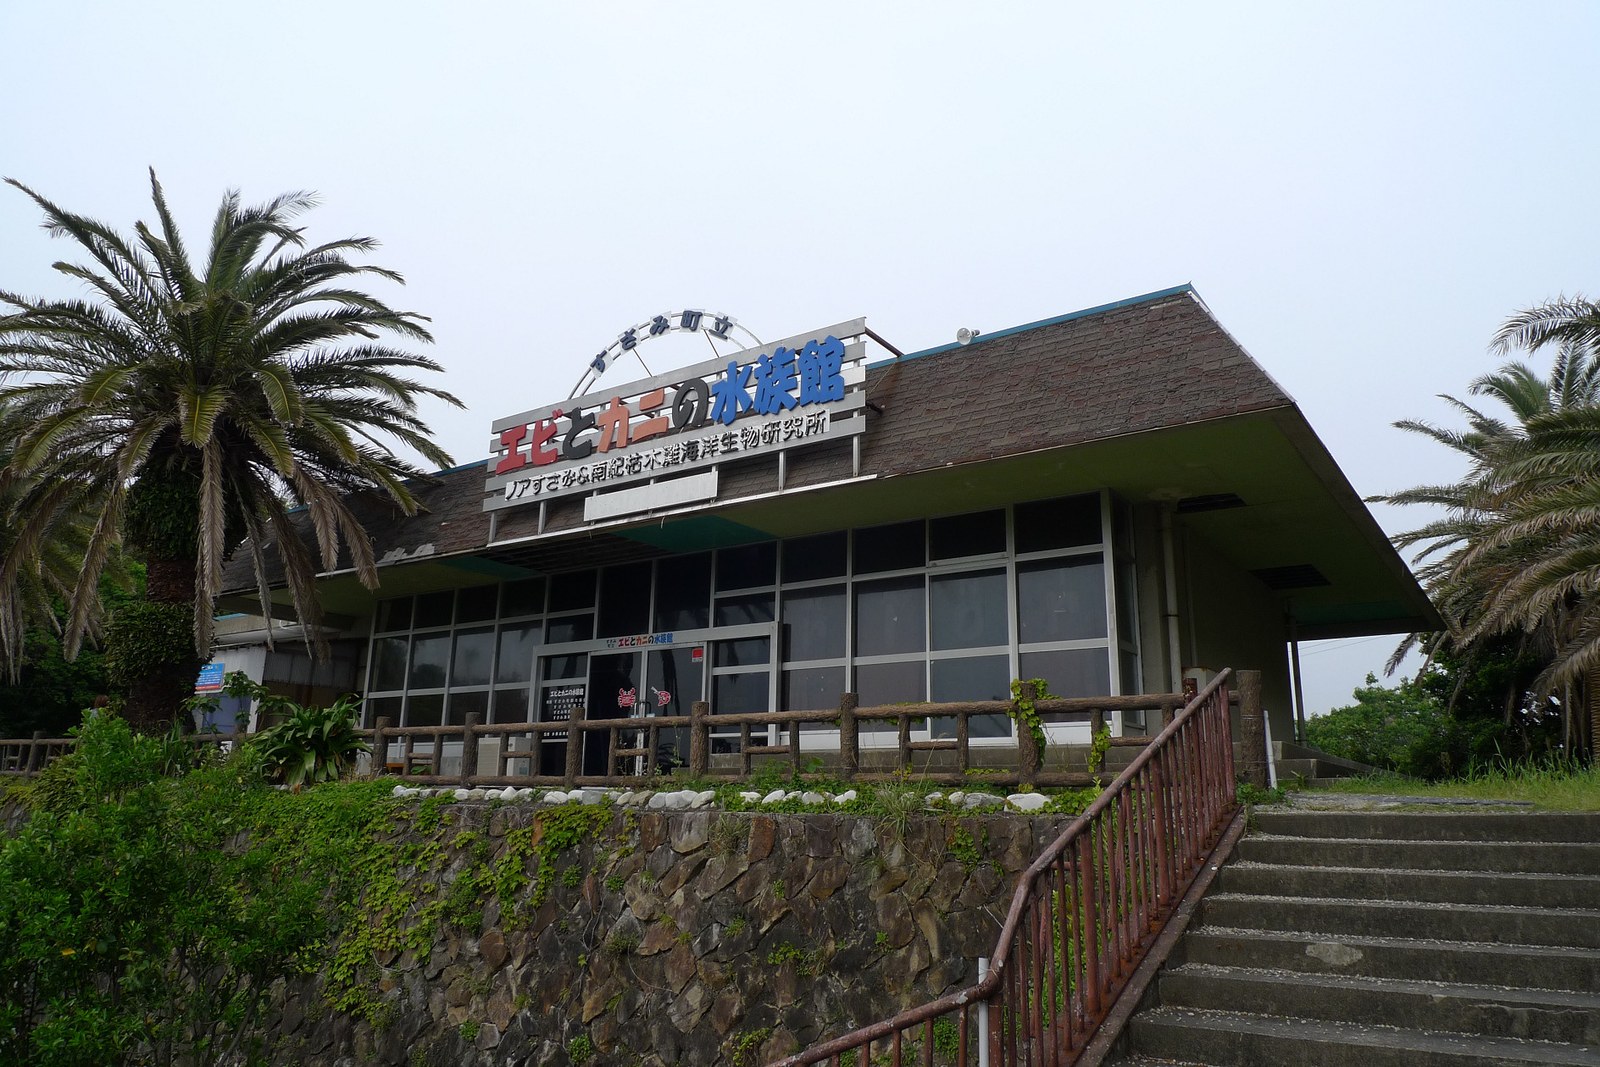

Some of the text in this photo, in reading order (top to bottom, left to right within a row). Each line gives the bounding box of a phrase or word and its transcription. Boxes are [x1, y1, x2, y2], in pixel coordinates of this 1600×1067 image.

[590, 310, 733, 373] すさみ町立
[495, 334, 846, 475] エビとカニの水族館
